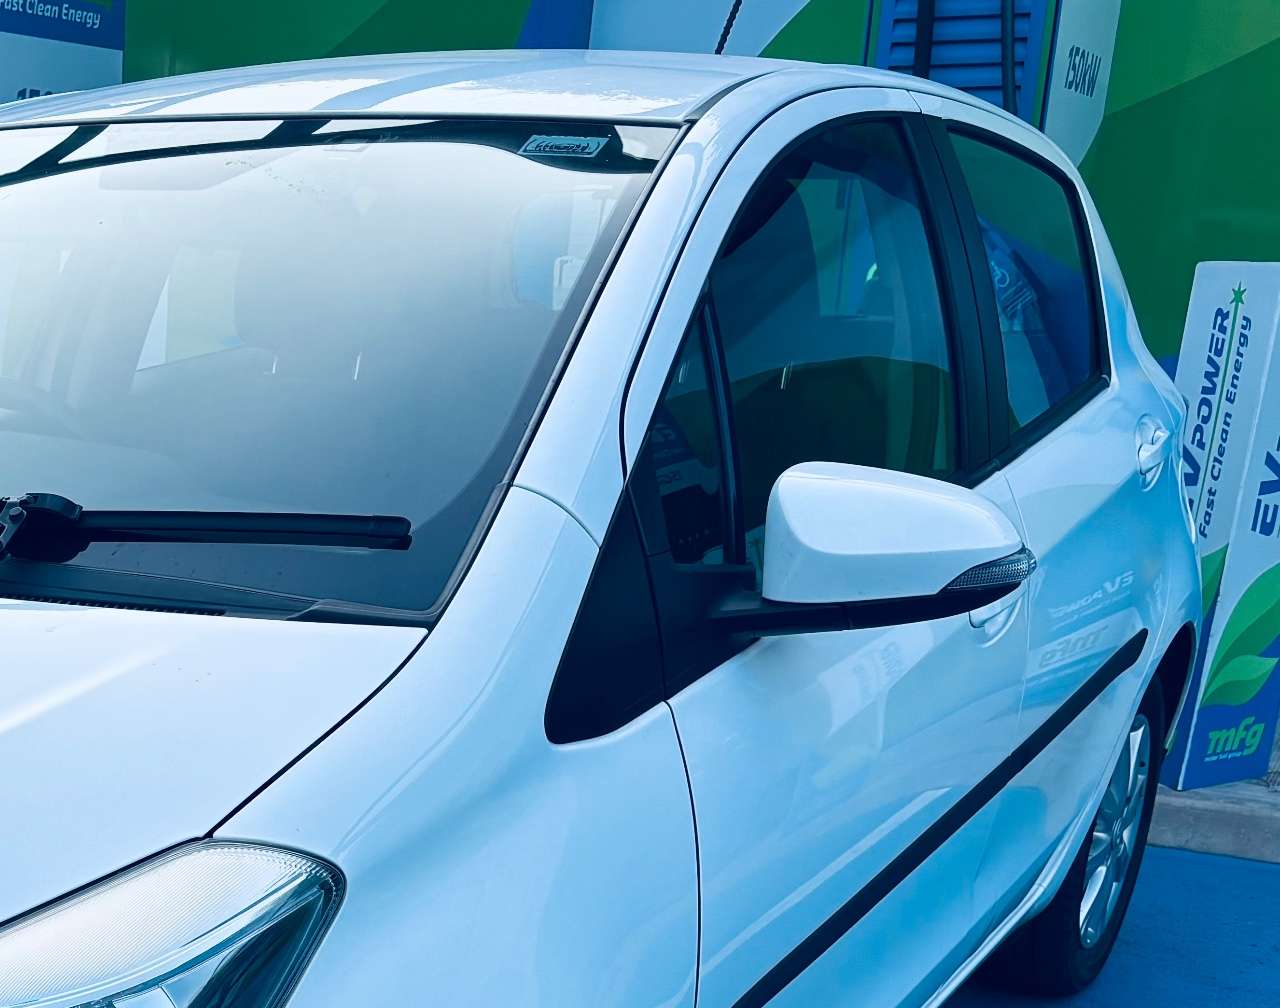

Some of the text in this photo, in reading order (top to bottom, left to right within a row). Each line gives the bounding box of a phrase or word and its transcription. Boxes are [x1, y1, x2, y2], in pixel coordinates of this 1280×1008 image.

[26, 0, 59, 18] Clean
[61, 3, 101, 28] Energy
[1064, 44, 1101, 98] 150kW
[1198, 314, 1252, 539] Fast Clean Energy
[1207, 716, 1264, 756] mfg
